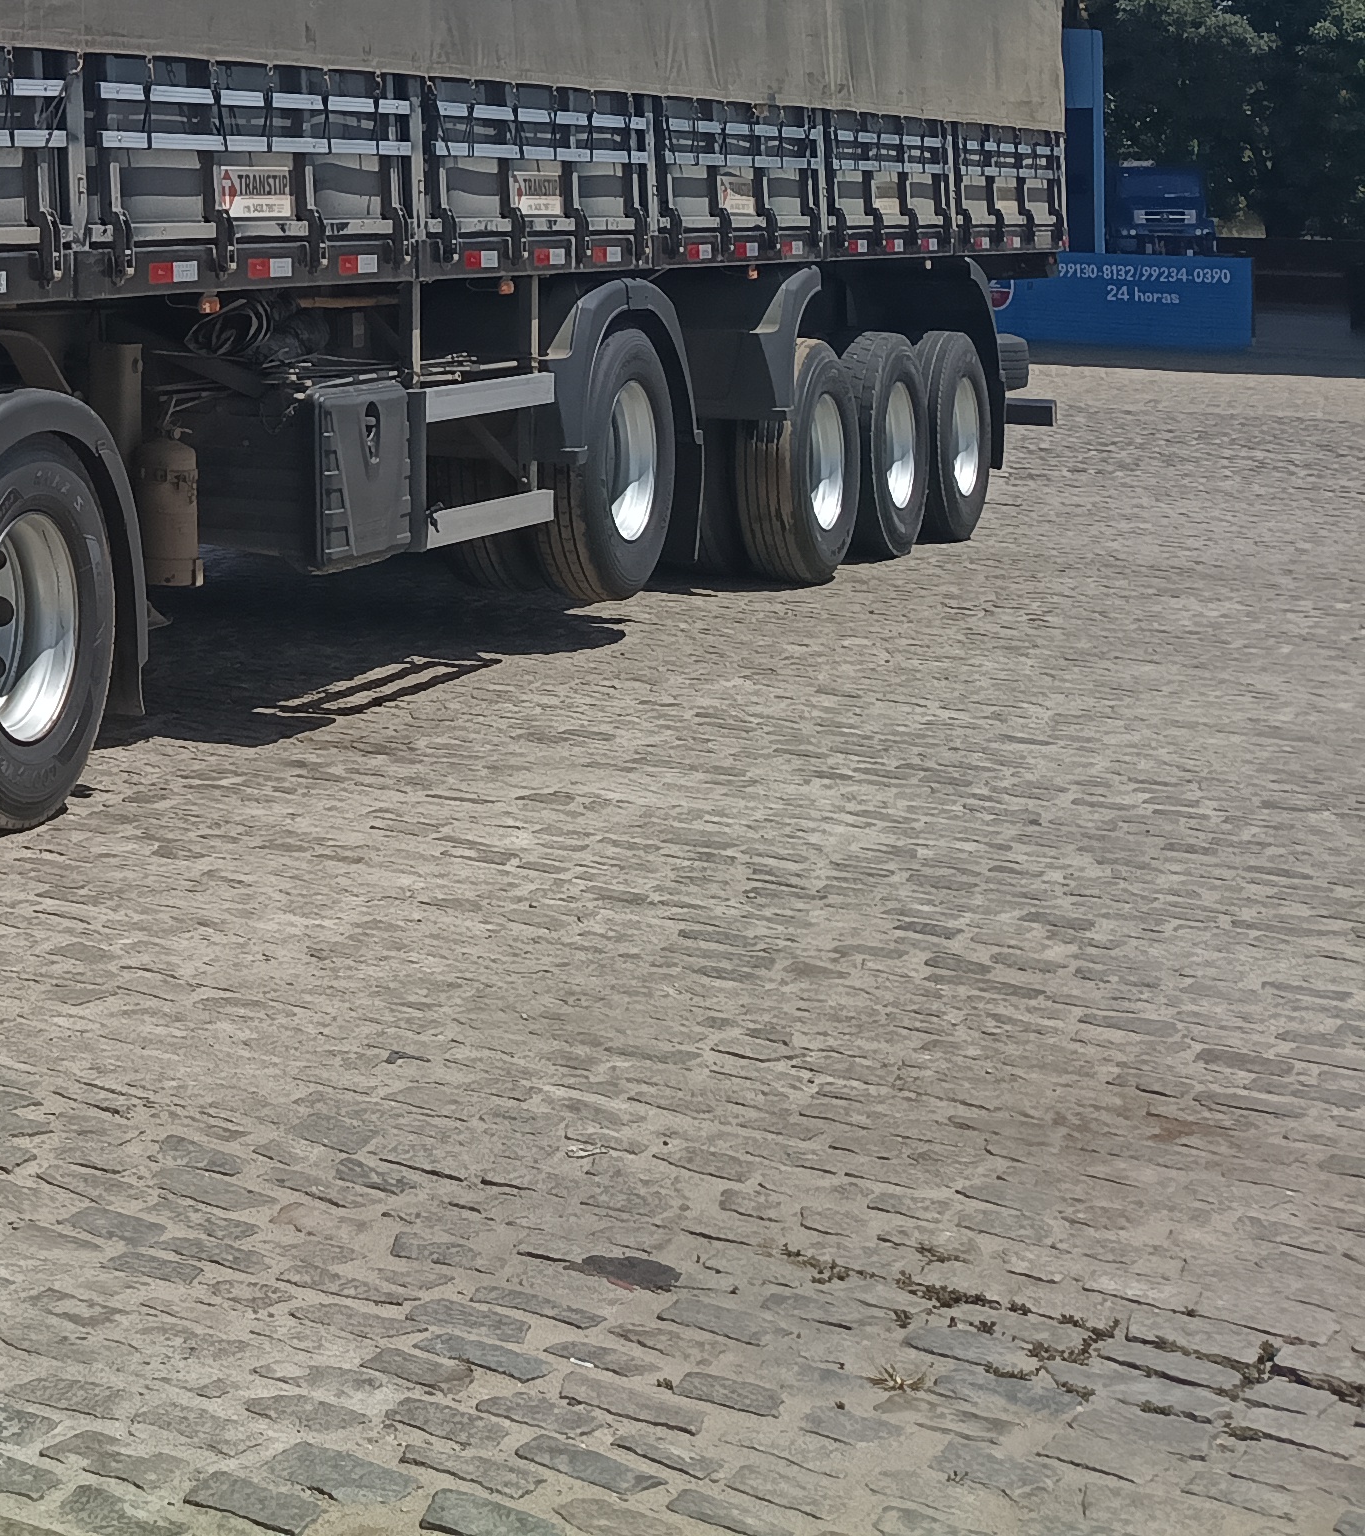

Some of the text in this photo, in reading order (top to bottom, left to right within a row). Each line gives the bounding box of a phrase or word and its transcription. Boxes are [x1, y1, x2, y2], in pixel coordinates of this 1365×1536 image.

[237, 174, 288, 196] TRANSTIP
[1106, 285, 1180, 304] 24 horas
